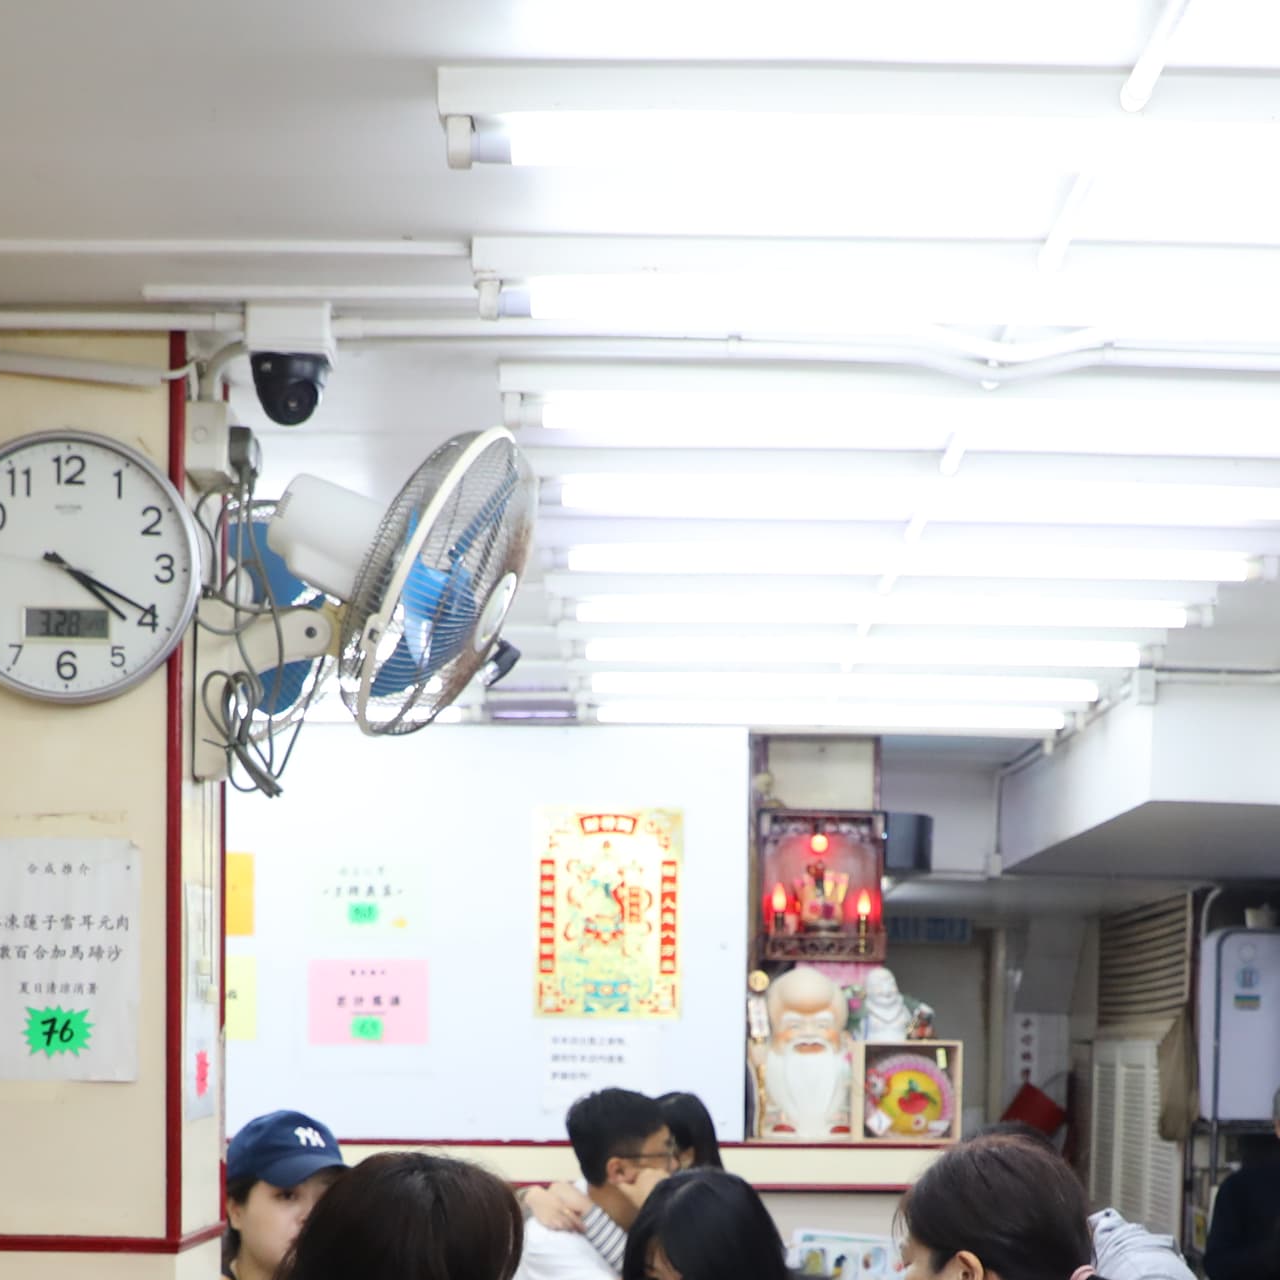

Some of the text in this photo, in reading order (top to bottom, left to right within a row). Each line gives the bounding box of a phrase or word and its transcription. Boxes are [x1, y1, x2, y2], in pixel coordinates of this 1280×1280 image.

[6, 466, 32, 497] 11
[52, 455, 86, 485] 12
[113, 469, 123, 500] 1
[140, 505, 162, 536] 2
[154, 553, 175, 584] 3
[136, 604, 159, 633] 4
[8, 644, 24, 666] 7
[56, 650, 78, 681] 6
[110, 646, 127, 668] 5
[40, 1016, 75, 1047] 76
